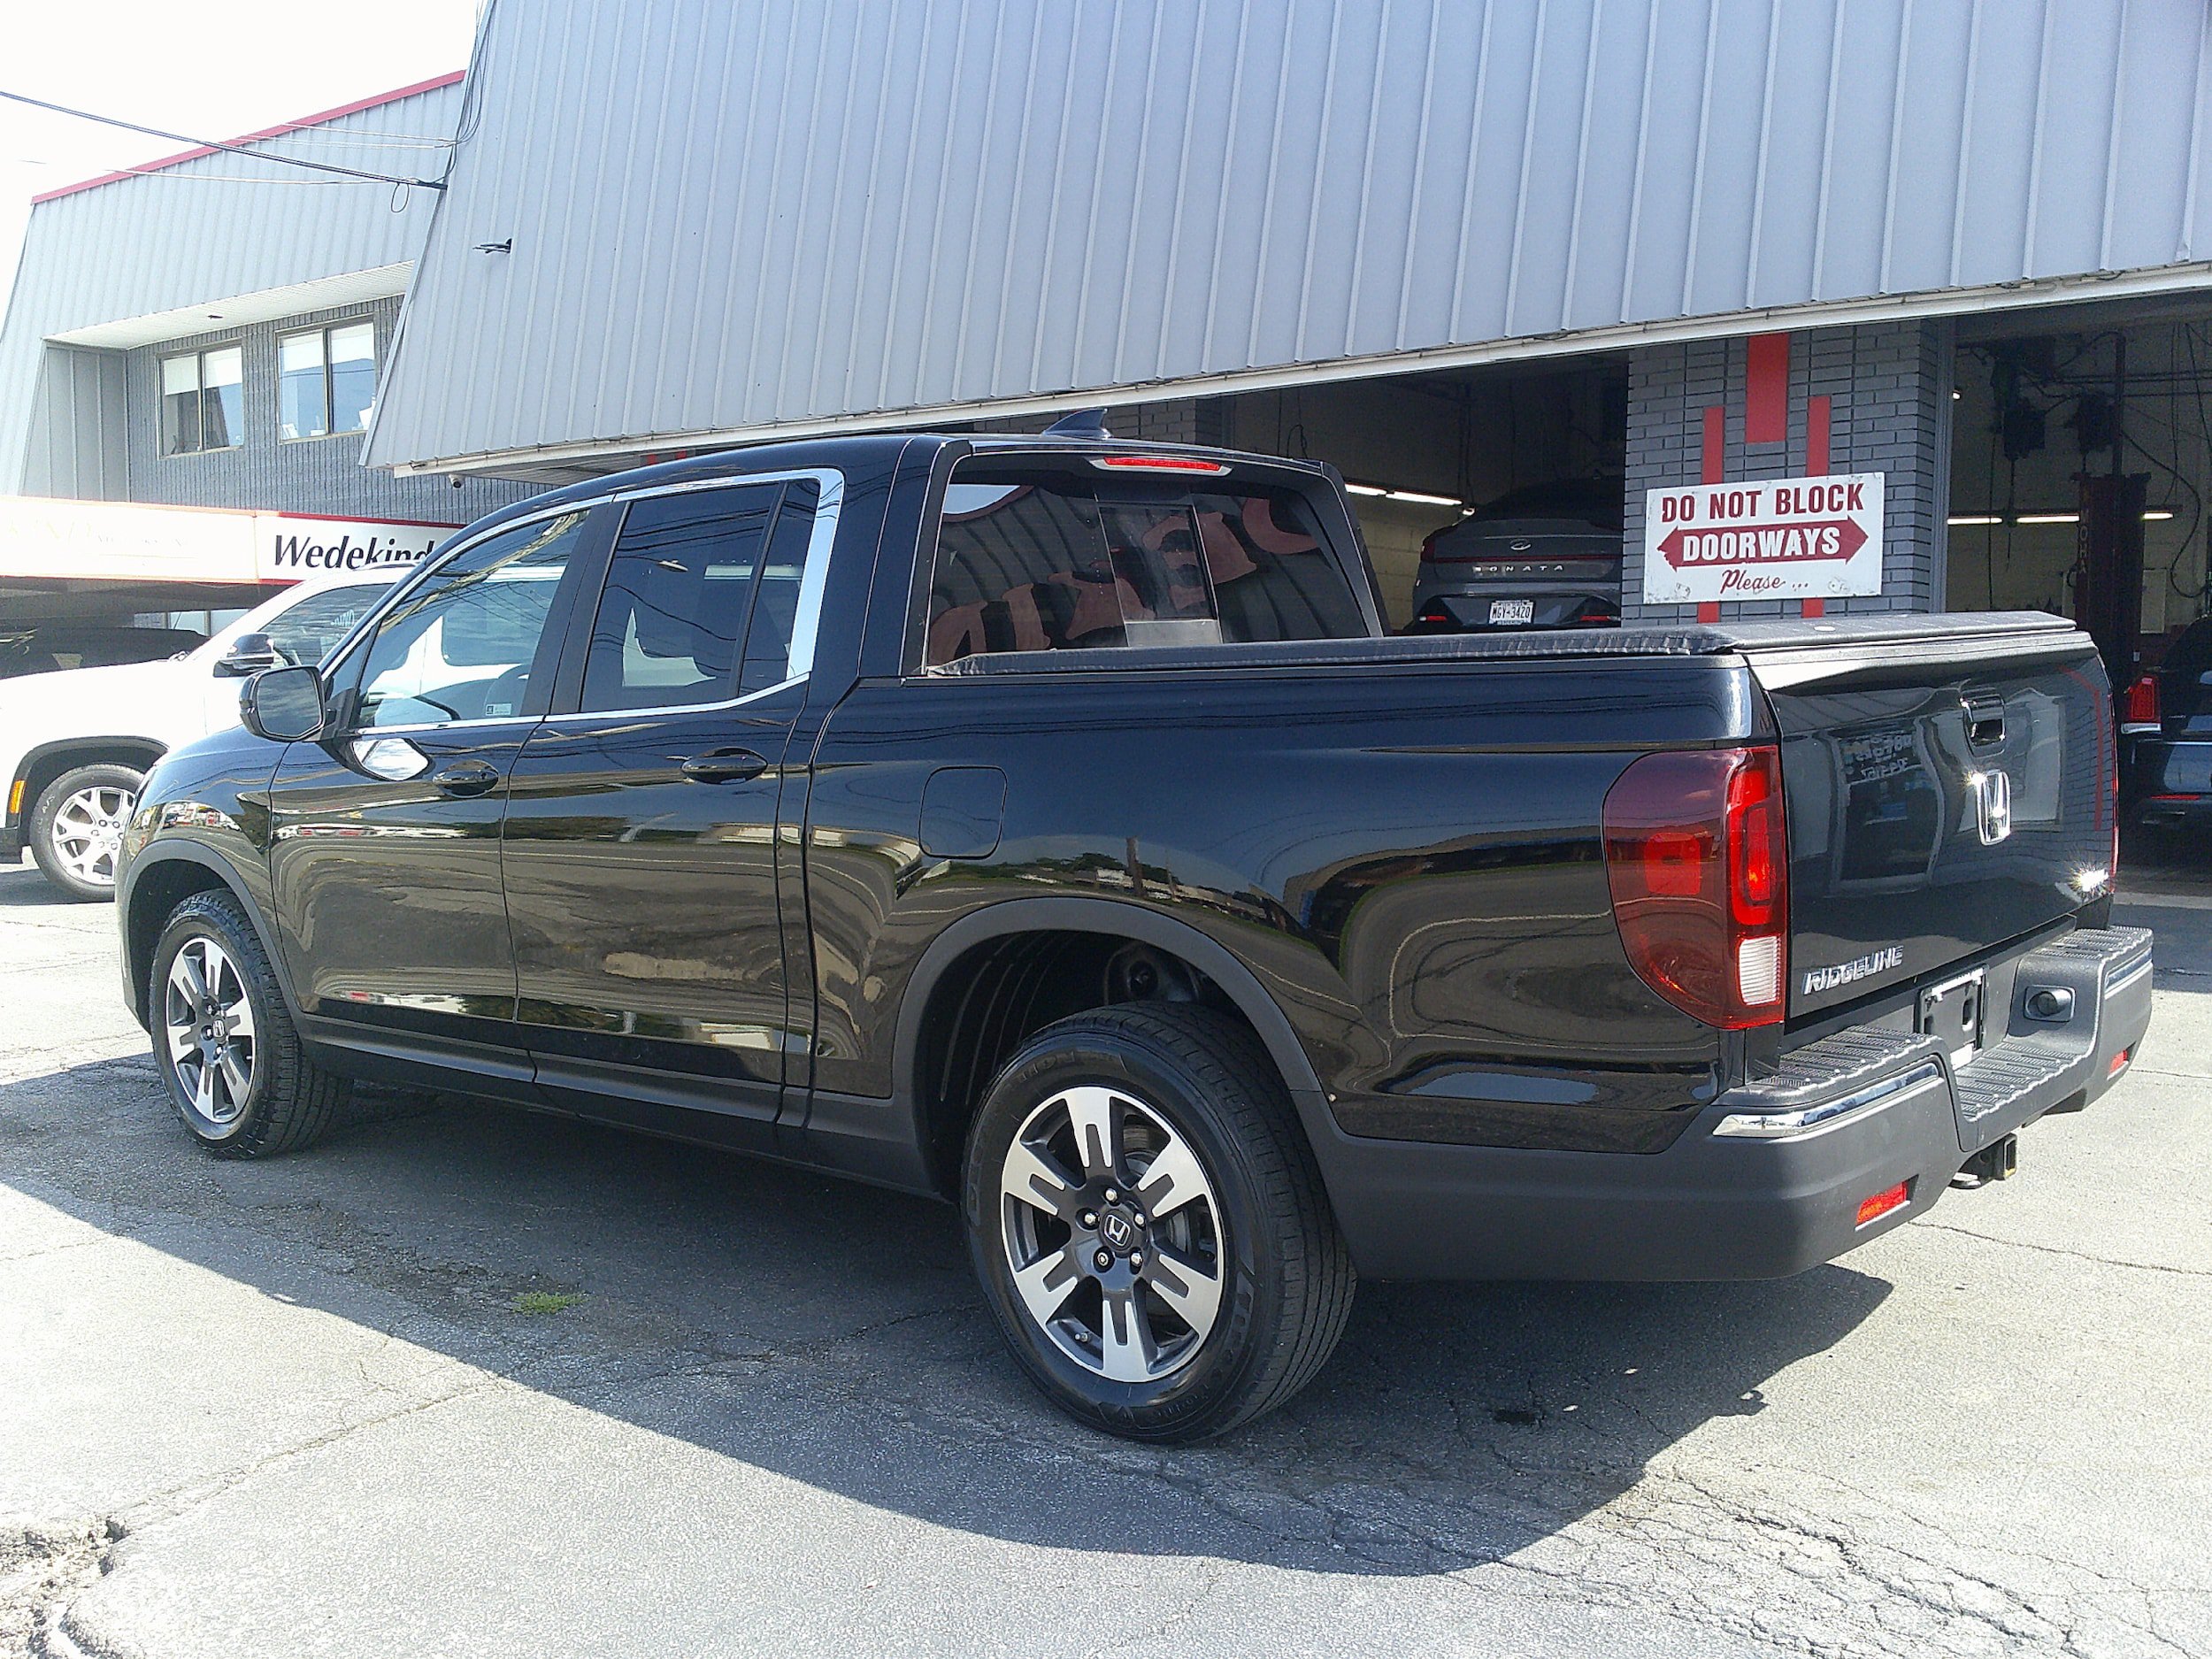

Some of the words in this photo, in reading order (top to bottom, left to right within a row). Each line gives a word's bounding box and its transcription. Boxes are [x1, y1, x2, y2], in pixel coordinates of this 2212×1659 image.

[1662, 495, 1694, 522] DO
[1709, 490, 1762, 519] NOT
[1775, 483, 1863, 515] BLOCK
[1683, 527, 1840, 562] DOORWAYS
[1720, 569, 1786, 594] Please
[1802, 945, 1904, 995] RIDGELINE
